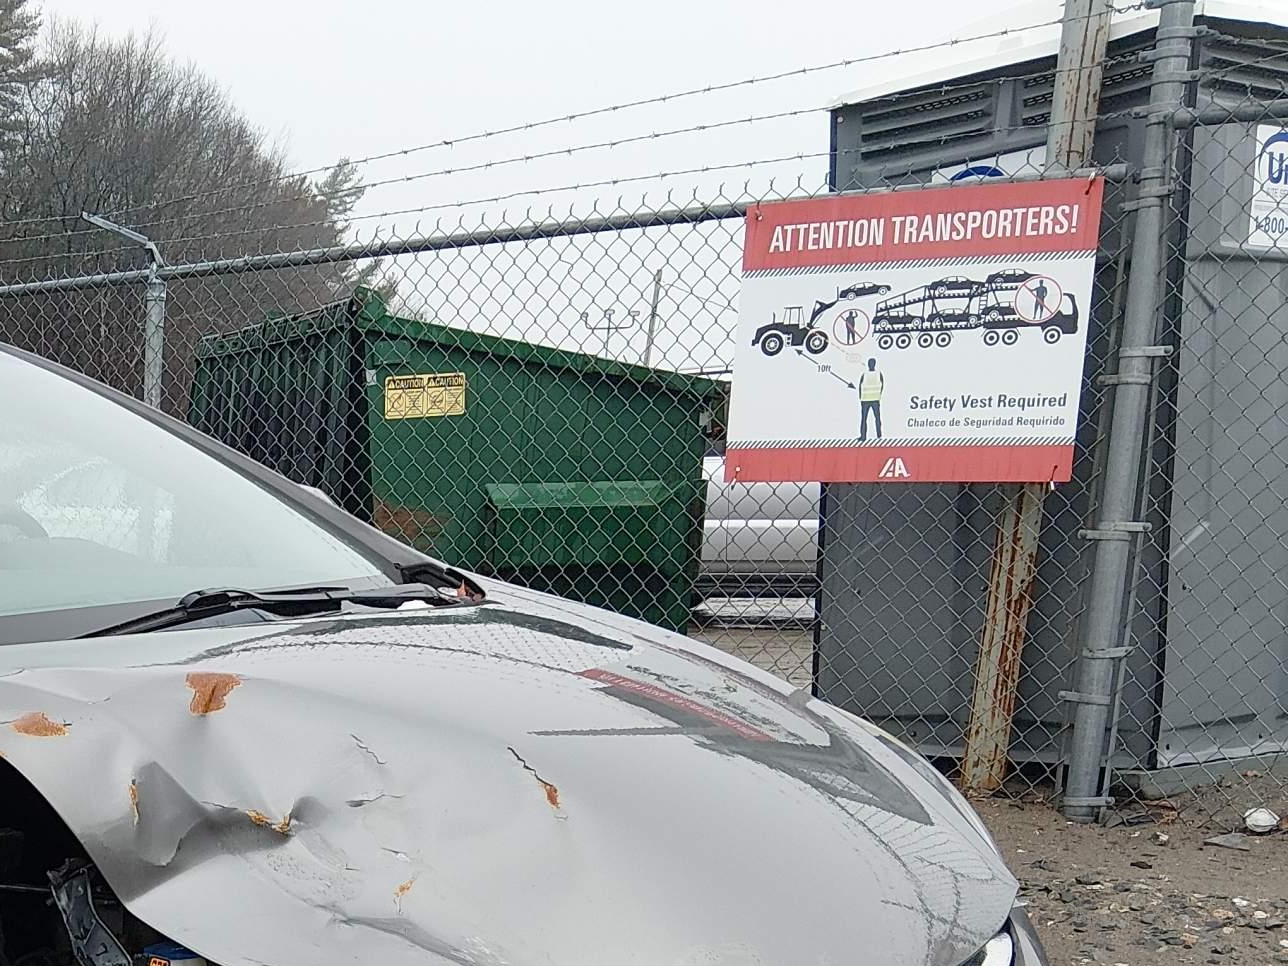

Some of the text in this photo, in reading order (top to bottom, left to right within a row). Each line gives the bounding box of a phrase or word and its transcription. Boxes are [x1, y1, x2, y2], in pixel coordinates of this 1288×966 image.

[769, 204, 1079, 253] ATTENTION TRANSPORTERS!
[395, 379, 424, 389] CAUTION
[436, 376, 464, 386] CAUTION
[909, 392, 1068, 412] Safety Vest Required
[907, 415, 1066, 429] Chaleco de Seguridad Requirido
